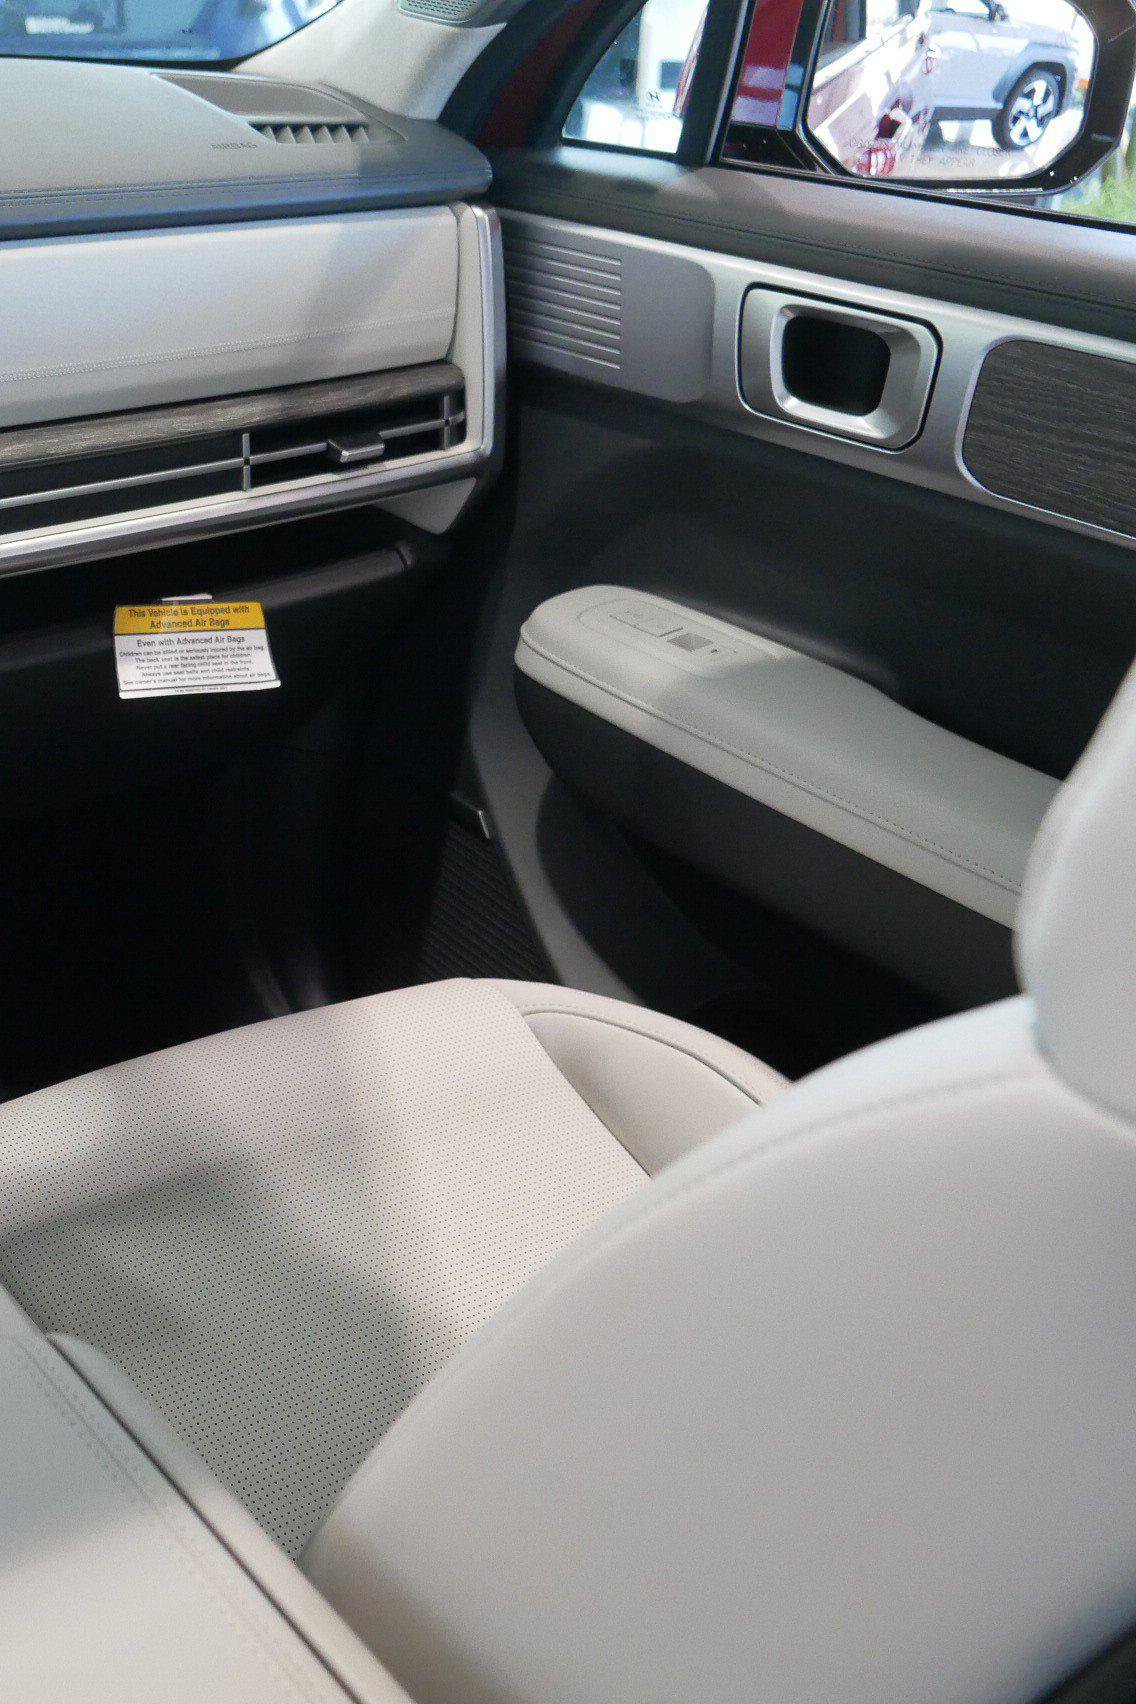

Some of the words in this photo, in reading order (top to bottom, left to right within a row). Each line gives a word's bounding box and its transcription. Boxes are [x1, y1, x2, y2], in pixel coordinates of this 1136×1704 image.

[128, 609, 146, 618] This
[147, 608, 179, 617] Vehicle
[180, 608, 188, 616] is
[190, 606, 231, 617] Equipped
[232, 605, 250, 614] with
[150, 619, 193, 629] Advanced
[195, 618, 207, 627] Air
[209, 617, 230, 628] Bags
[137, 639, 157, 648] Even
[158, 638, 175, 646] with
[176, 637, 213, 645] Advanced
[215, 636, 226, 644] Air
[227, 635, 245, 644] Bags
